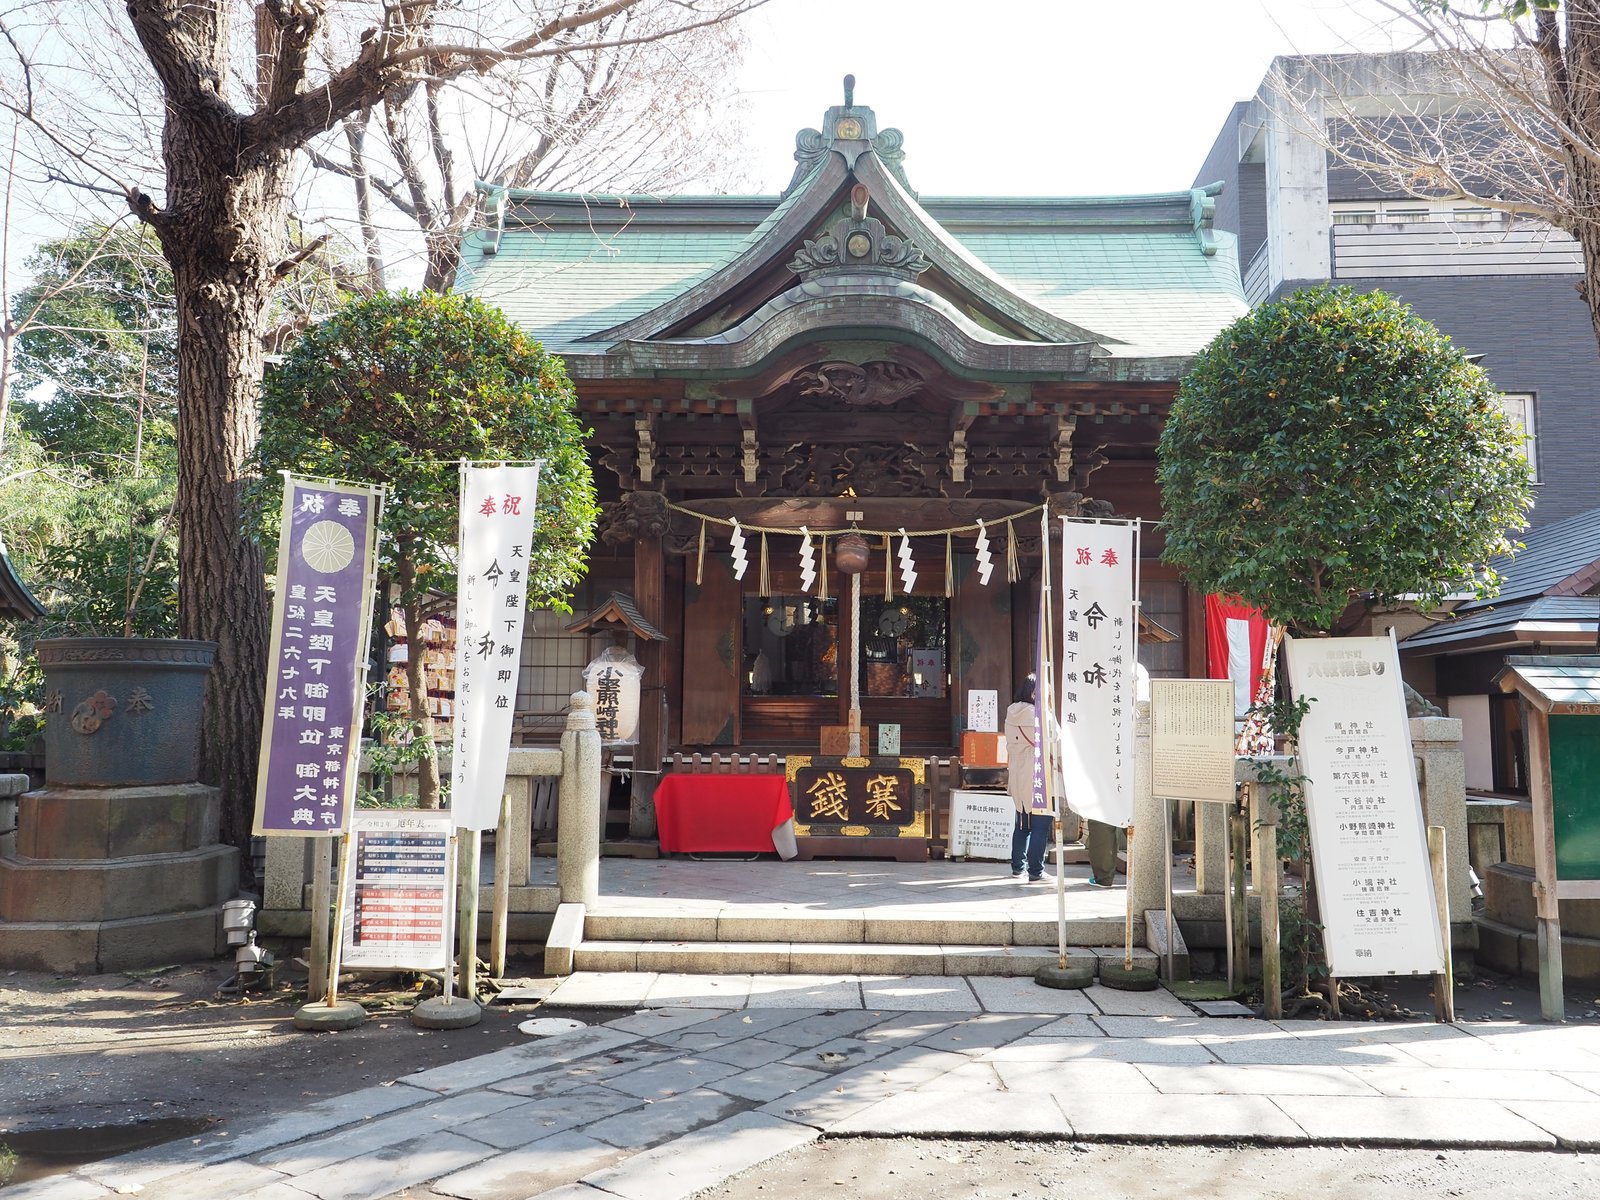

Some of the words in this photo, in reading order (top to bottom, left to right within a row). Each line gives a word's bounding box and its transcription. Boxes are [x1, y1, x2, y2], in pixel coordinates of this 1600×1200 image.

[478, 494, 522, 518] 奉祝
[477, 558, 504, 661] 令和
[495, 545, 523, 709] 天皇陛下御即位
[458, 575, 476, 783] 新しい御代をお祝いしましょう
[126, 686, 155, 715] 奉
[1342, 796, 1386, 805] 下谷神社
[1356, 908, 1402, 917] 住吉神社
